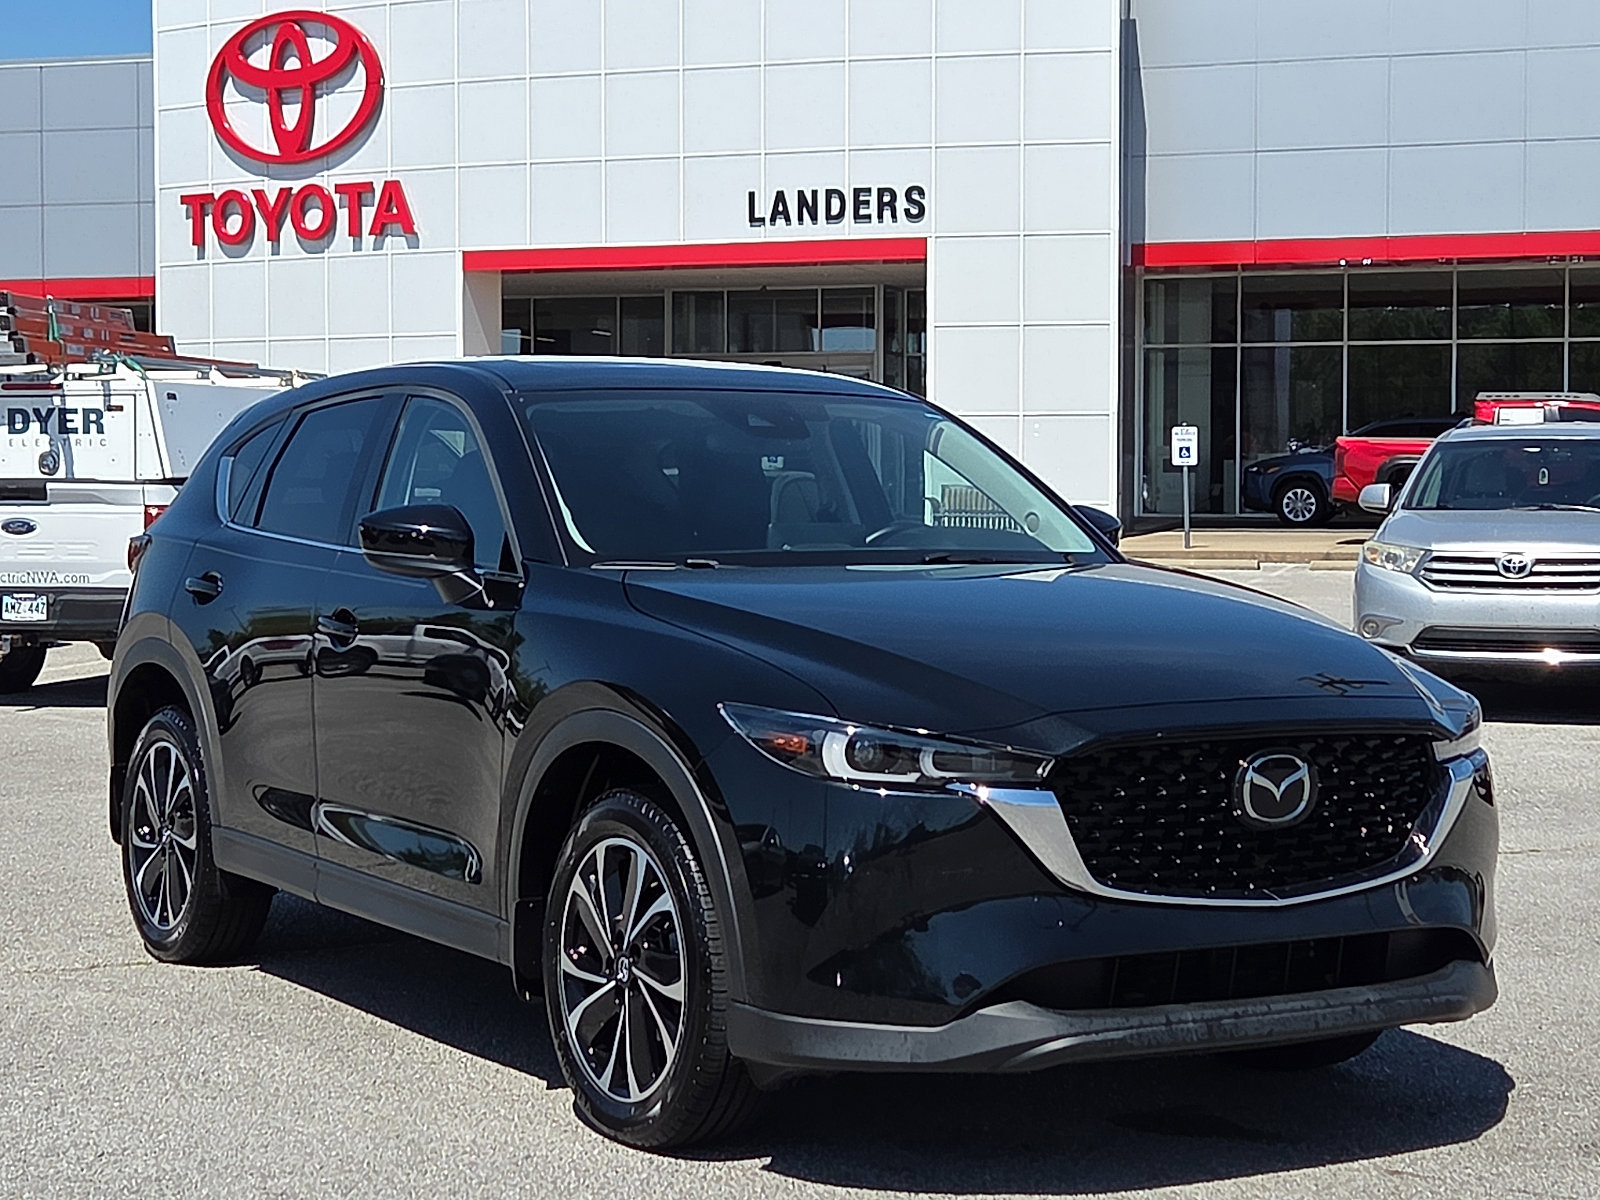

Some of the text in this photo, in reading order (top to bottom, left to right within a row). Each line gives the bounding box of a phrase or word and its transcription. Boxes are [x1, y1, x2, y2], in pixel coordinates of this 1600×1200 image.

[180, 180, 417, 246] TOYOTA
[748, 186, 926, 227] LANDERS
[7, 408, 105, 435] DYER
[9, 438, 107, 447] ELECTRIC
[0, 571, 90, 584] ctricNWA.com
